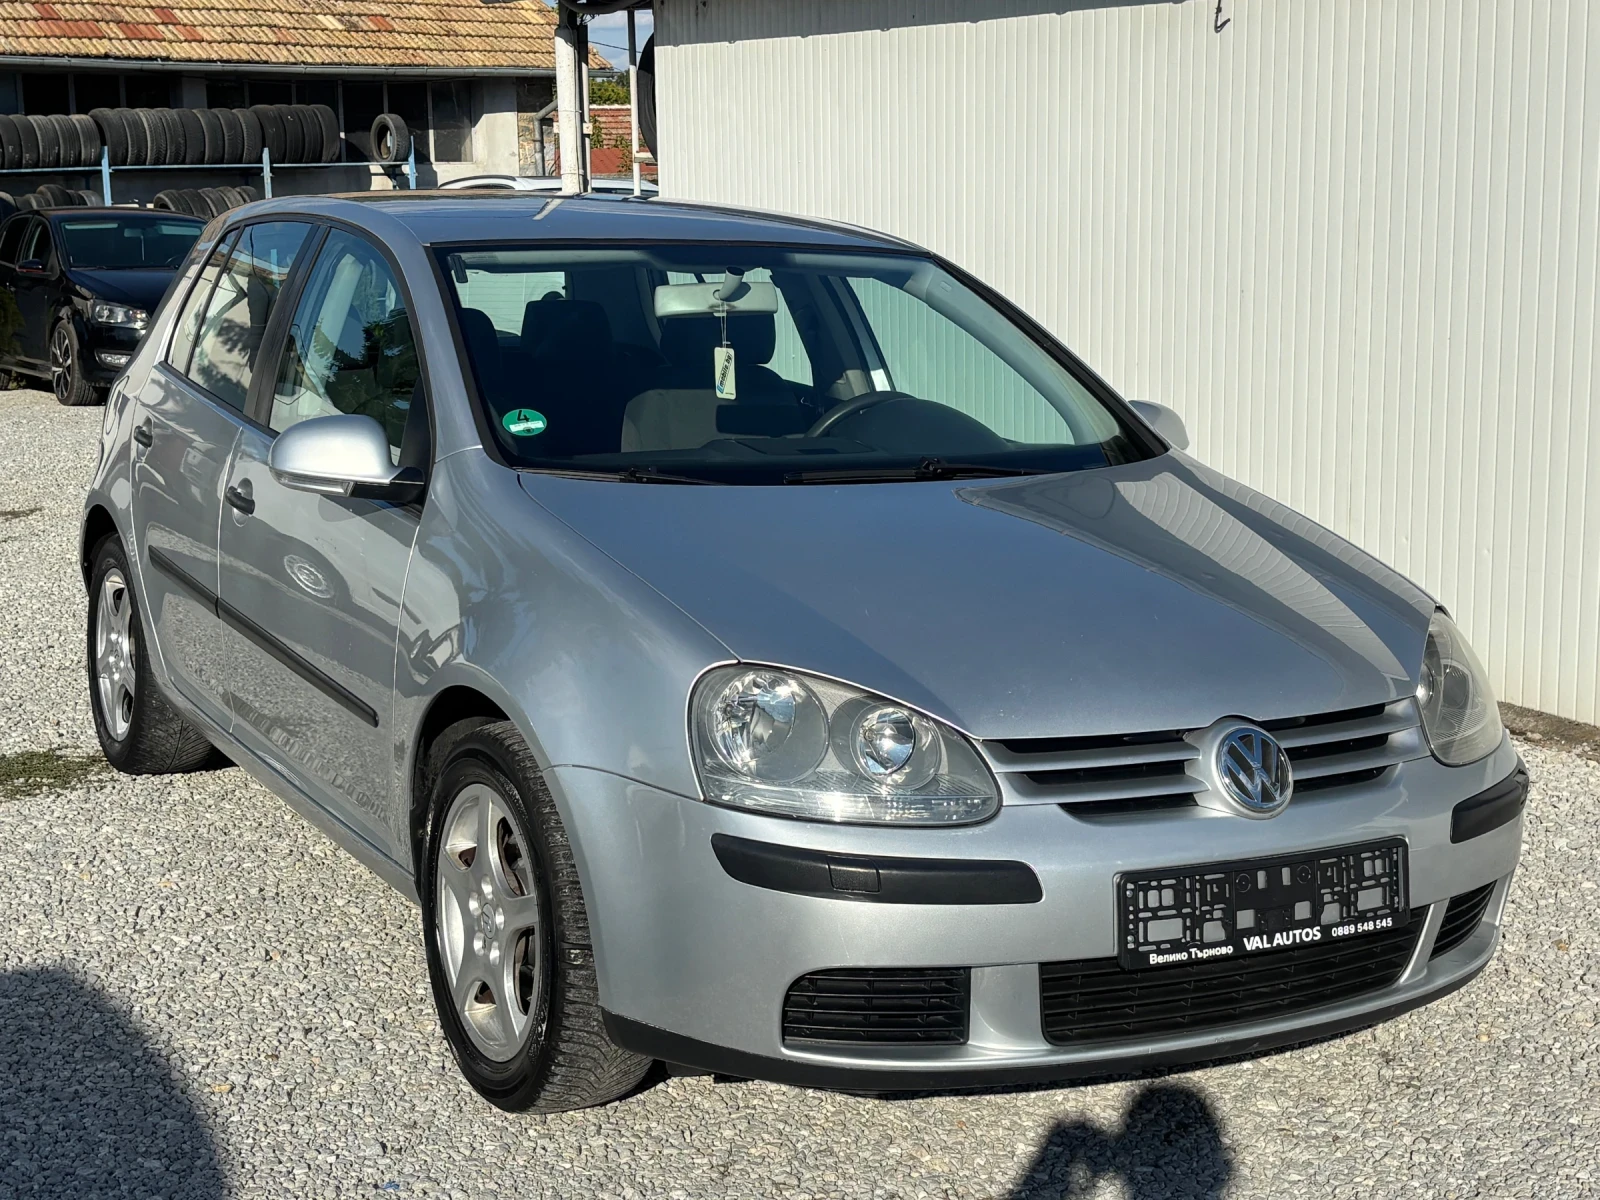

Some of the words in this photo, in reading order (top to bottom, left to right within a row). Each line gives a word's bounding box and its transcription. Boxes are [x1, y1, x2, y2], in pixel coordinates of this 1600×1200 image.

[517, 409, 530, 422] 4
[1331, 925, 1355, 937] 0889
[1357, 921, 1374, 933] 548
[1375, 917, 1393, 929] 545
[1243, 934, 1271, 951] VAL
[1273, 926, 1322, 947] AUTOS
[1149, 951, 1188, 965] Велико
[1189, 945, 1234, 959] Търново
